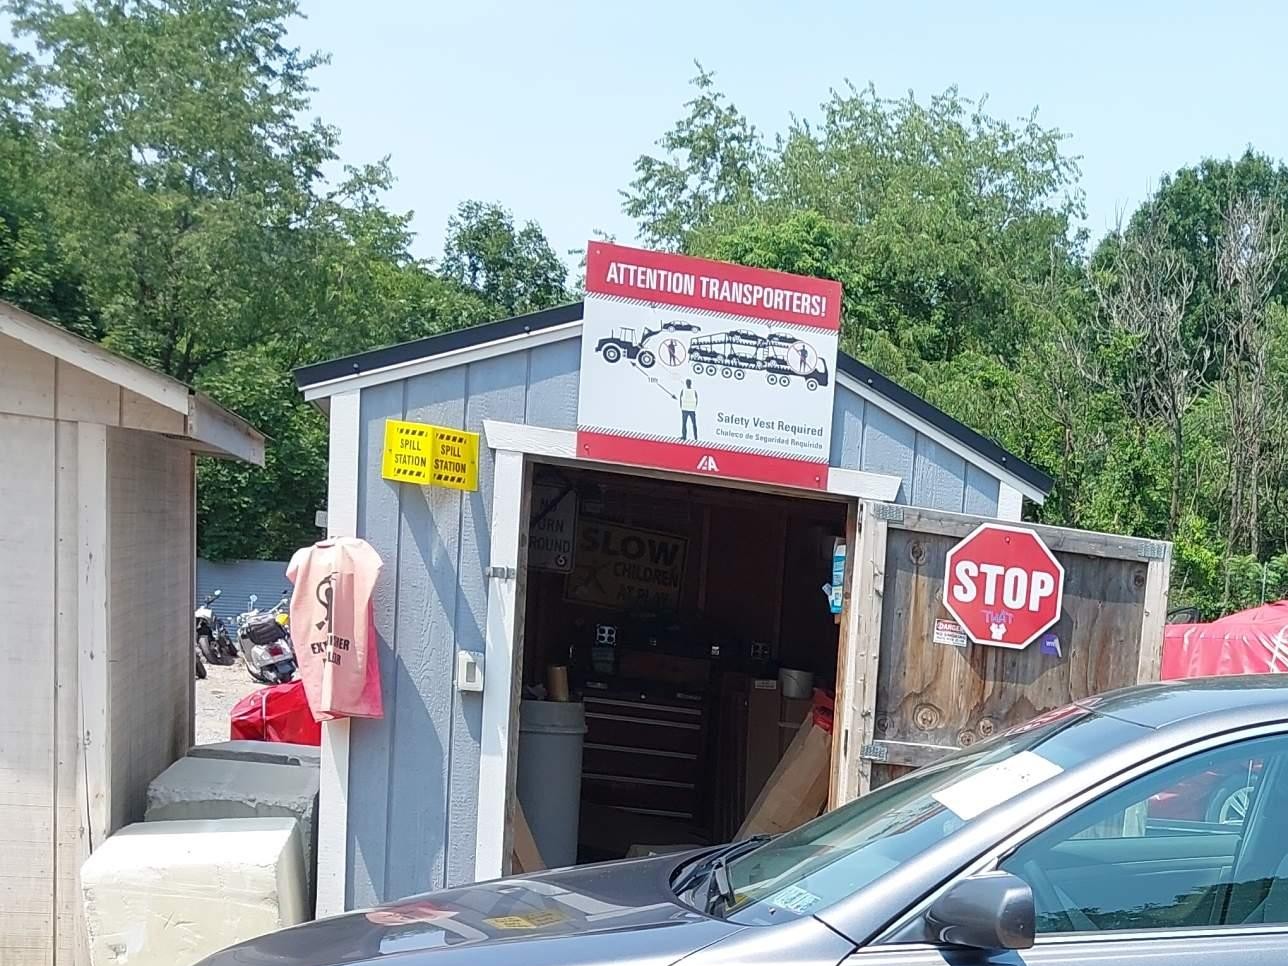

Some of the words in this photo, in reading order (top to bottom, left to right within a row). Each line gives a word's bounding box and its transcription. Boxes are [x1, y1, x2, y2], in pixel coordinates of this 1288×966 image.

[606, 262, 695, 296] ATTENTION
[700, 276, 826, 317] TRANSPORTERS!
[717, 411, 750, 428] Safety
[753, 416, 775, 430] Vest
[777, 420, 823, 437] Required
[400, 438, 421, 451] SPILL
[715, 428, 744, 439] Chaleco
[745, 431, 754, 440] de
[755, 432, 789, 446] Seguridad
[440, 444, 462, 457] SPILL
[394, 453, 427, 467] STATION
[434, 458, 467, 473] STATION
[535, 516, 564, 532] URN
[529, 535, 570, 553] ROUND
[582, 527, 680, 566] SLOW
[613, 561, 678, 588] CHILDREN
[953, 560, 1055, 612] STOP
